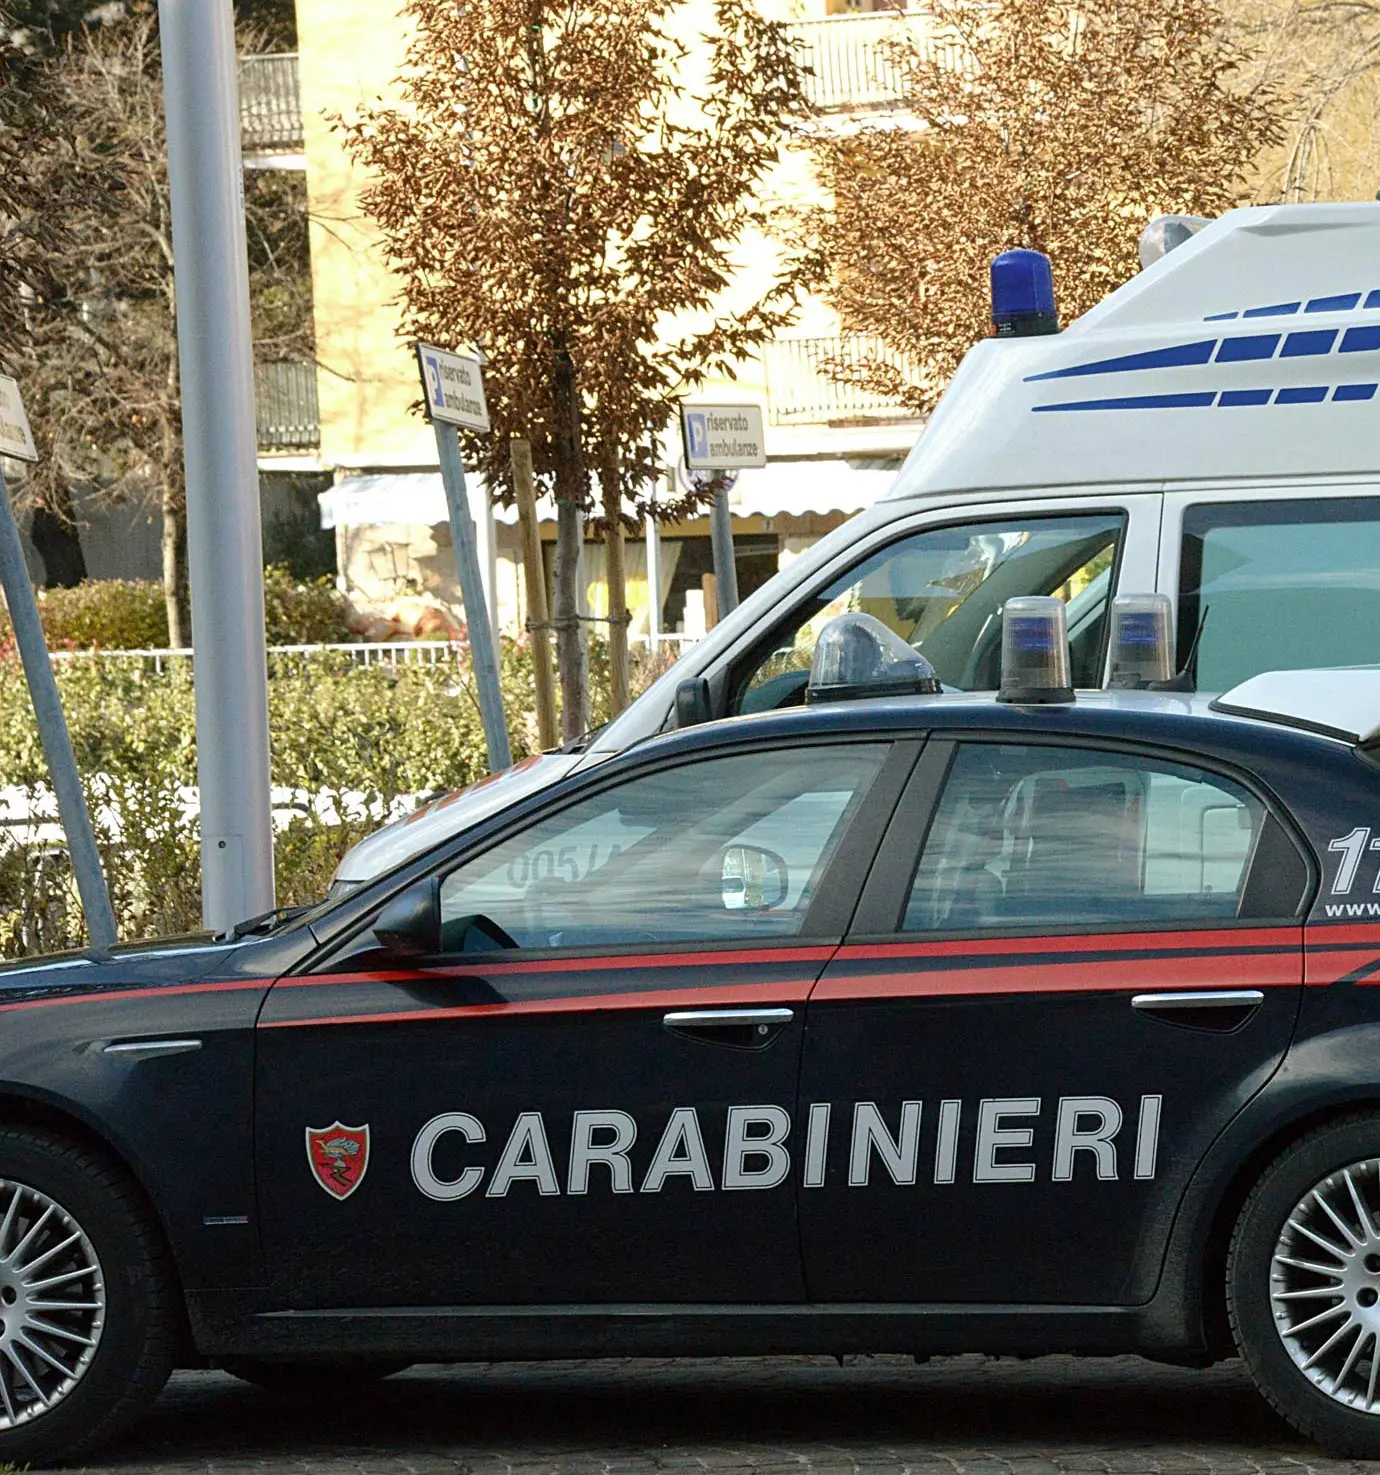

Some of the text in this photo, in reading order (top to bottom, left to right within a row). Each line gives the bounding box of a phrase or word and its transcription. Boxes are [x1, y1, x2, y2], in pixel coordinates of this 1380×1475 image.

[438, 356, 472, 387] riservato
[444, 389, 483, 417] ambulanze
[706, 411, 749, 432] riservato
[709, 437, 759, 458] ambulanze
[410, 1094, 1163, 1202] CARABINIERI
